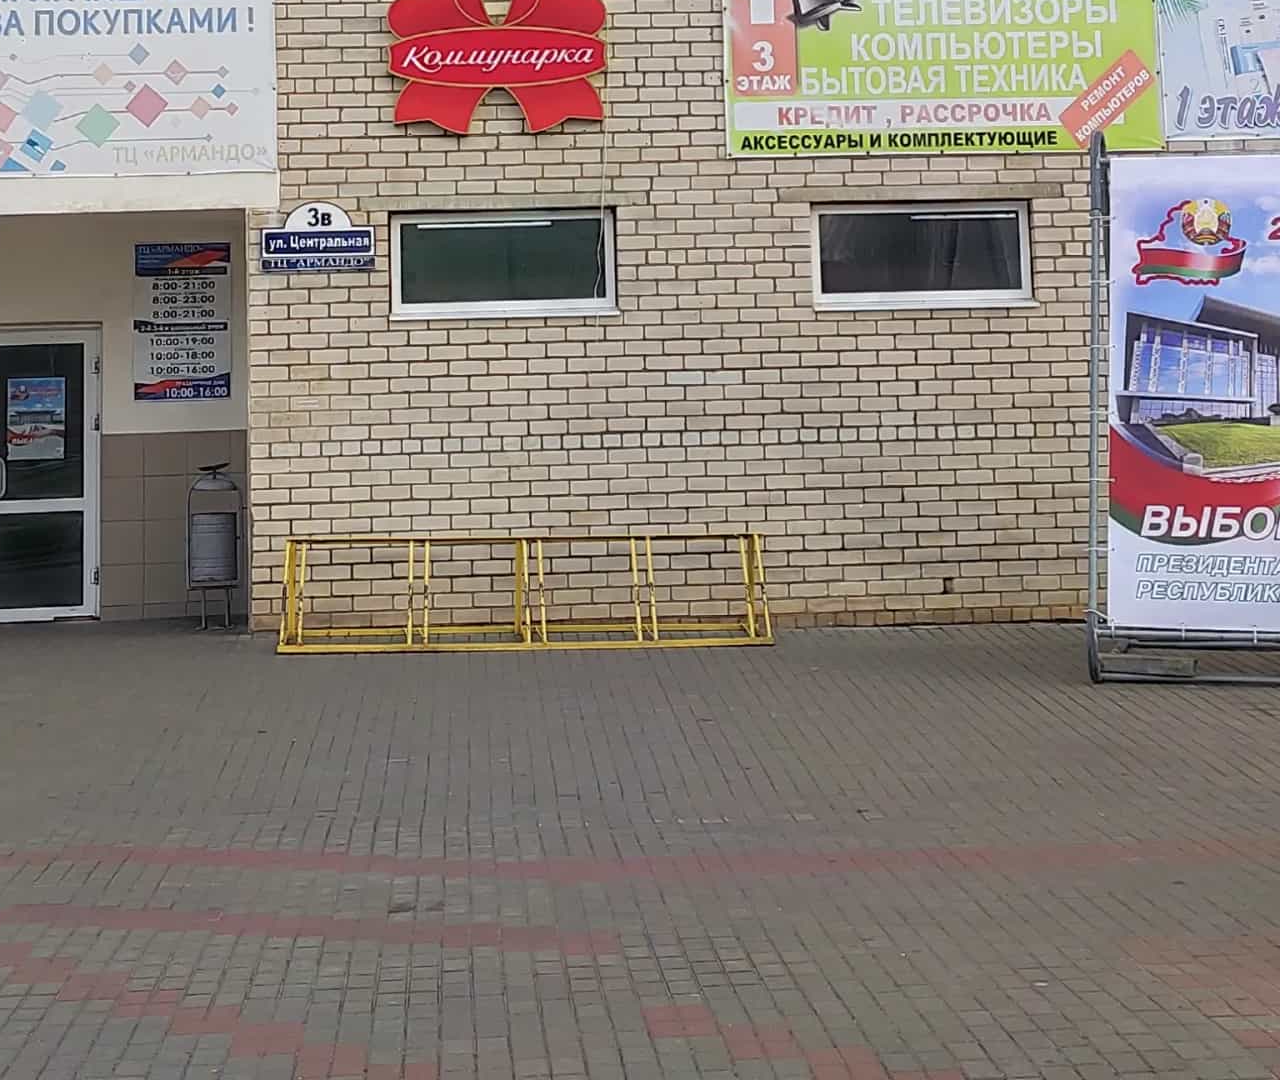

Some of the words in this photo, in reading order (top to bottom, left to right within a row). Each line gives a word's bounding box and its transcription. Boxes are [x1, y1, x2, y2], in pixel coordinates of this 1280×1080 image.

[33, 5, 239, 38] ПОКУПКАМИ
[400, 45, 595, 73] Коммунарка
[751, 40, 775, 73] 3
[850, 30, 1103, 62] КОМПЬЮТЕРЫ
[736, 74, 793, 93] ЭТАЖ
[801, 66, 947, 97] БЫТОВАЯ
[959, 63, 1089, 94] ТЕХНИКА
[1080, 65, 1127, 111] РЕМОНТ
[777, 103, 877, 128] КРЕДИТ
[900, 100, 1053, 124] РАССРОЧКА
[1074, 68, 1151, 142] КОМПЬЮТЕРОВ
[1174, 84, 1192, 130] 1
[112, 146, 139, 167] ТЦ
[142, 142, 269, 165] «АРМАНДО»
[740, 131, 864, 151] АКСЕССУАРЫ
[870, 132, 883, 148] И
[887, 130, 1058, 149] КОМПЛЕКТУЮЩИЕ
[268, 237, 288, 251] ул.
[290, 235, 370, 250] Центральная
[165, 387, 228, 398] 10:00-16:00
